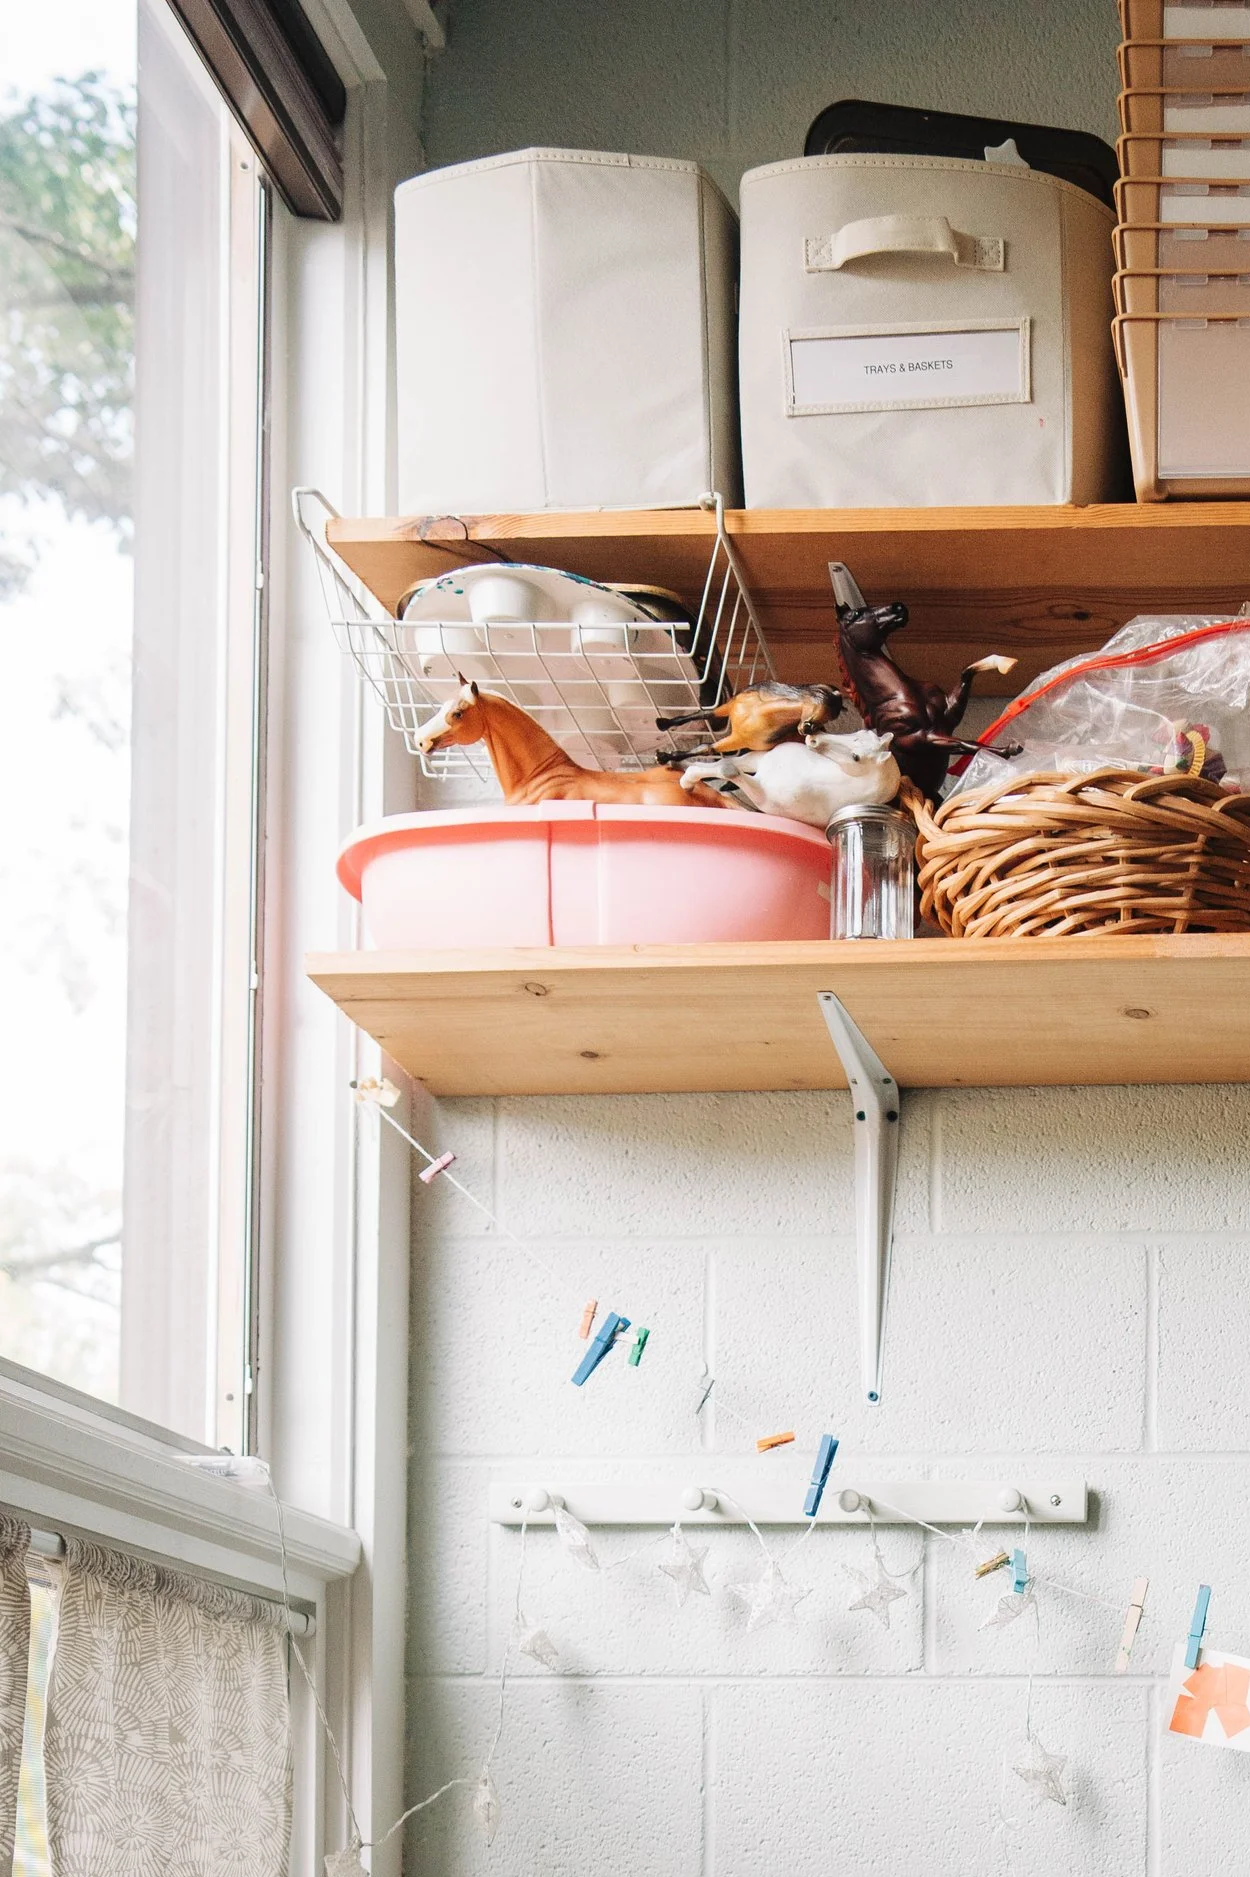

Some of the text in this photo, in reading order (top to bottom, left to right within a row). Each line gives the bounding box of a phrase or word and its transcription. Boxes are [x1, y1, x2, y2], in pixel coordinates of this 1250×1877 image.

[863, 359, 954, 375] TRAYS & BASKETS
